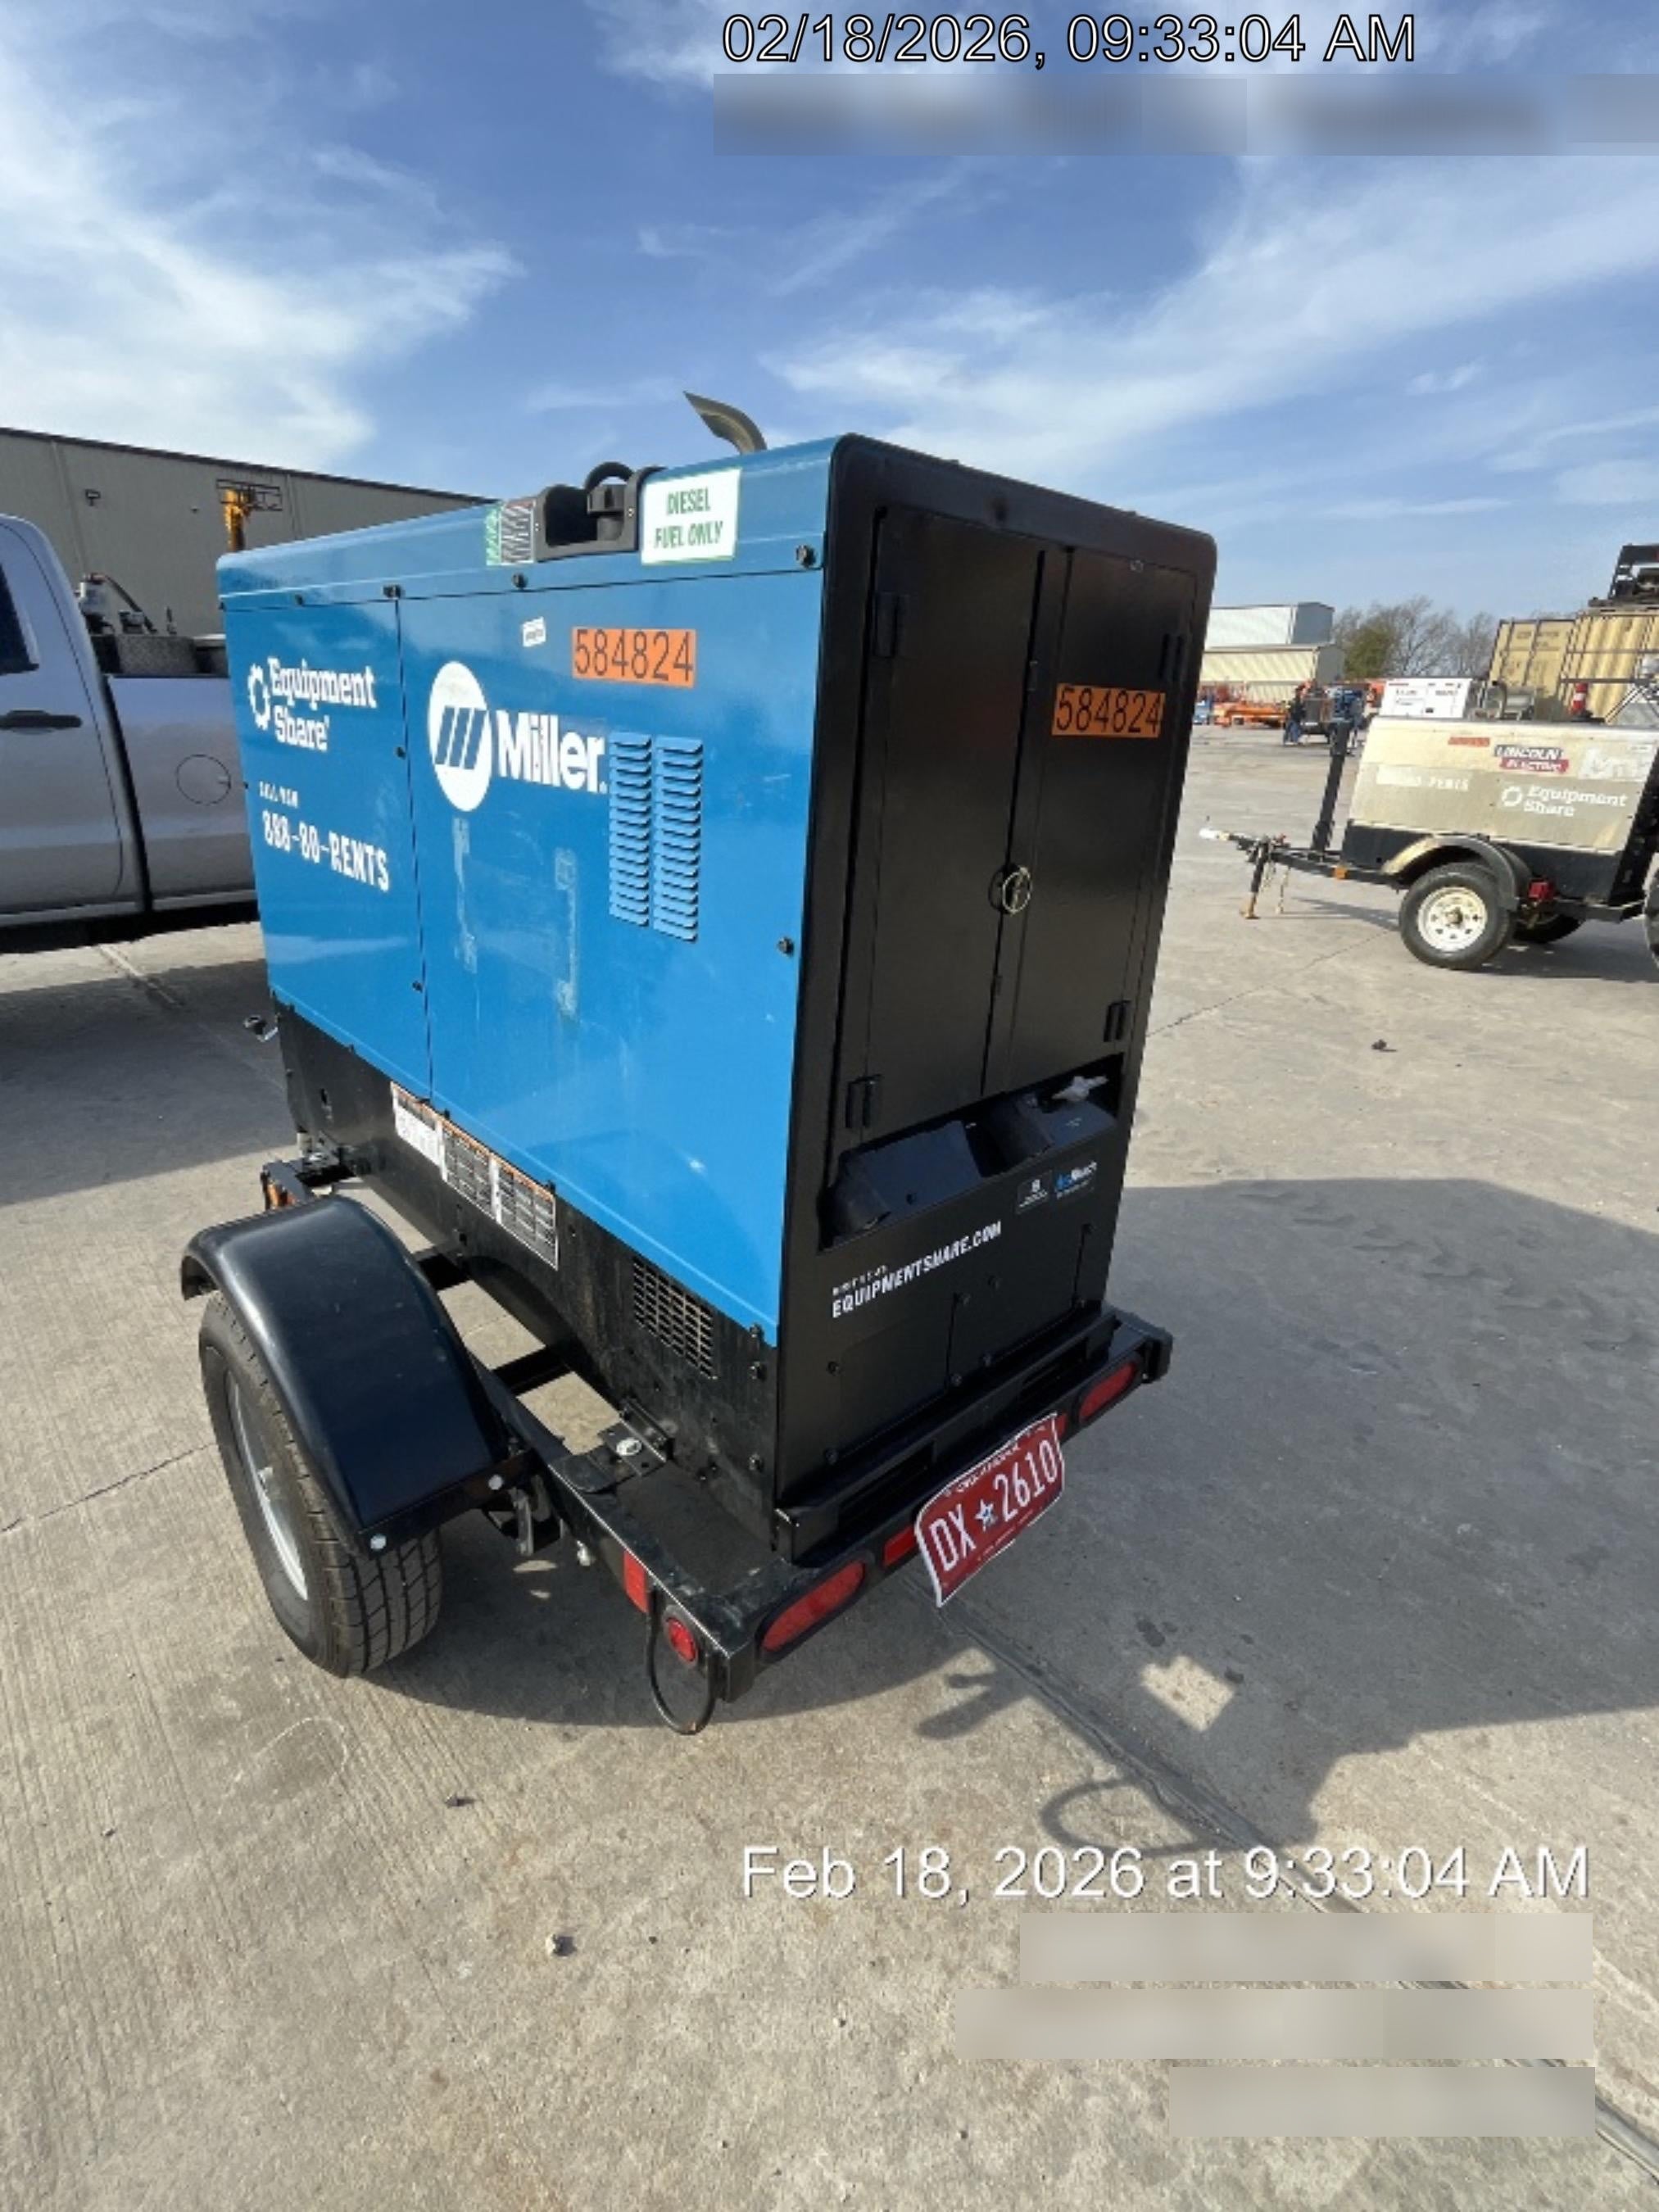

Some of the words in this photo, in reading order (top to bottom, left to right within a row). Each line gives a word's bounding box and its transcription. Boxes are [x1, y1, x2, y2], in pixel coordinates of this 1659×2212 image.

[667, 486, 711, 515] DIESEL
[655, 525, 684, 550] FUEL
[687, 520, 724, 545] ONLY
[574, 628, 694, 682] 584824
[267, 656, 378, 711] Equipment
[1056, 684, 1162, 735] 584824
[1523, 800, 1575, 818] Share
[1527, 784, 1628, 808] Equipment
[832, 1219, 1002, 1319] EQUIPMENTSHARE.COM
